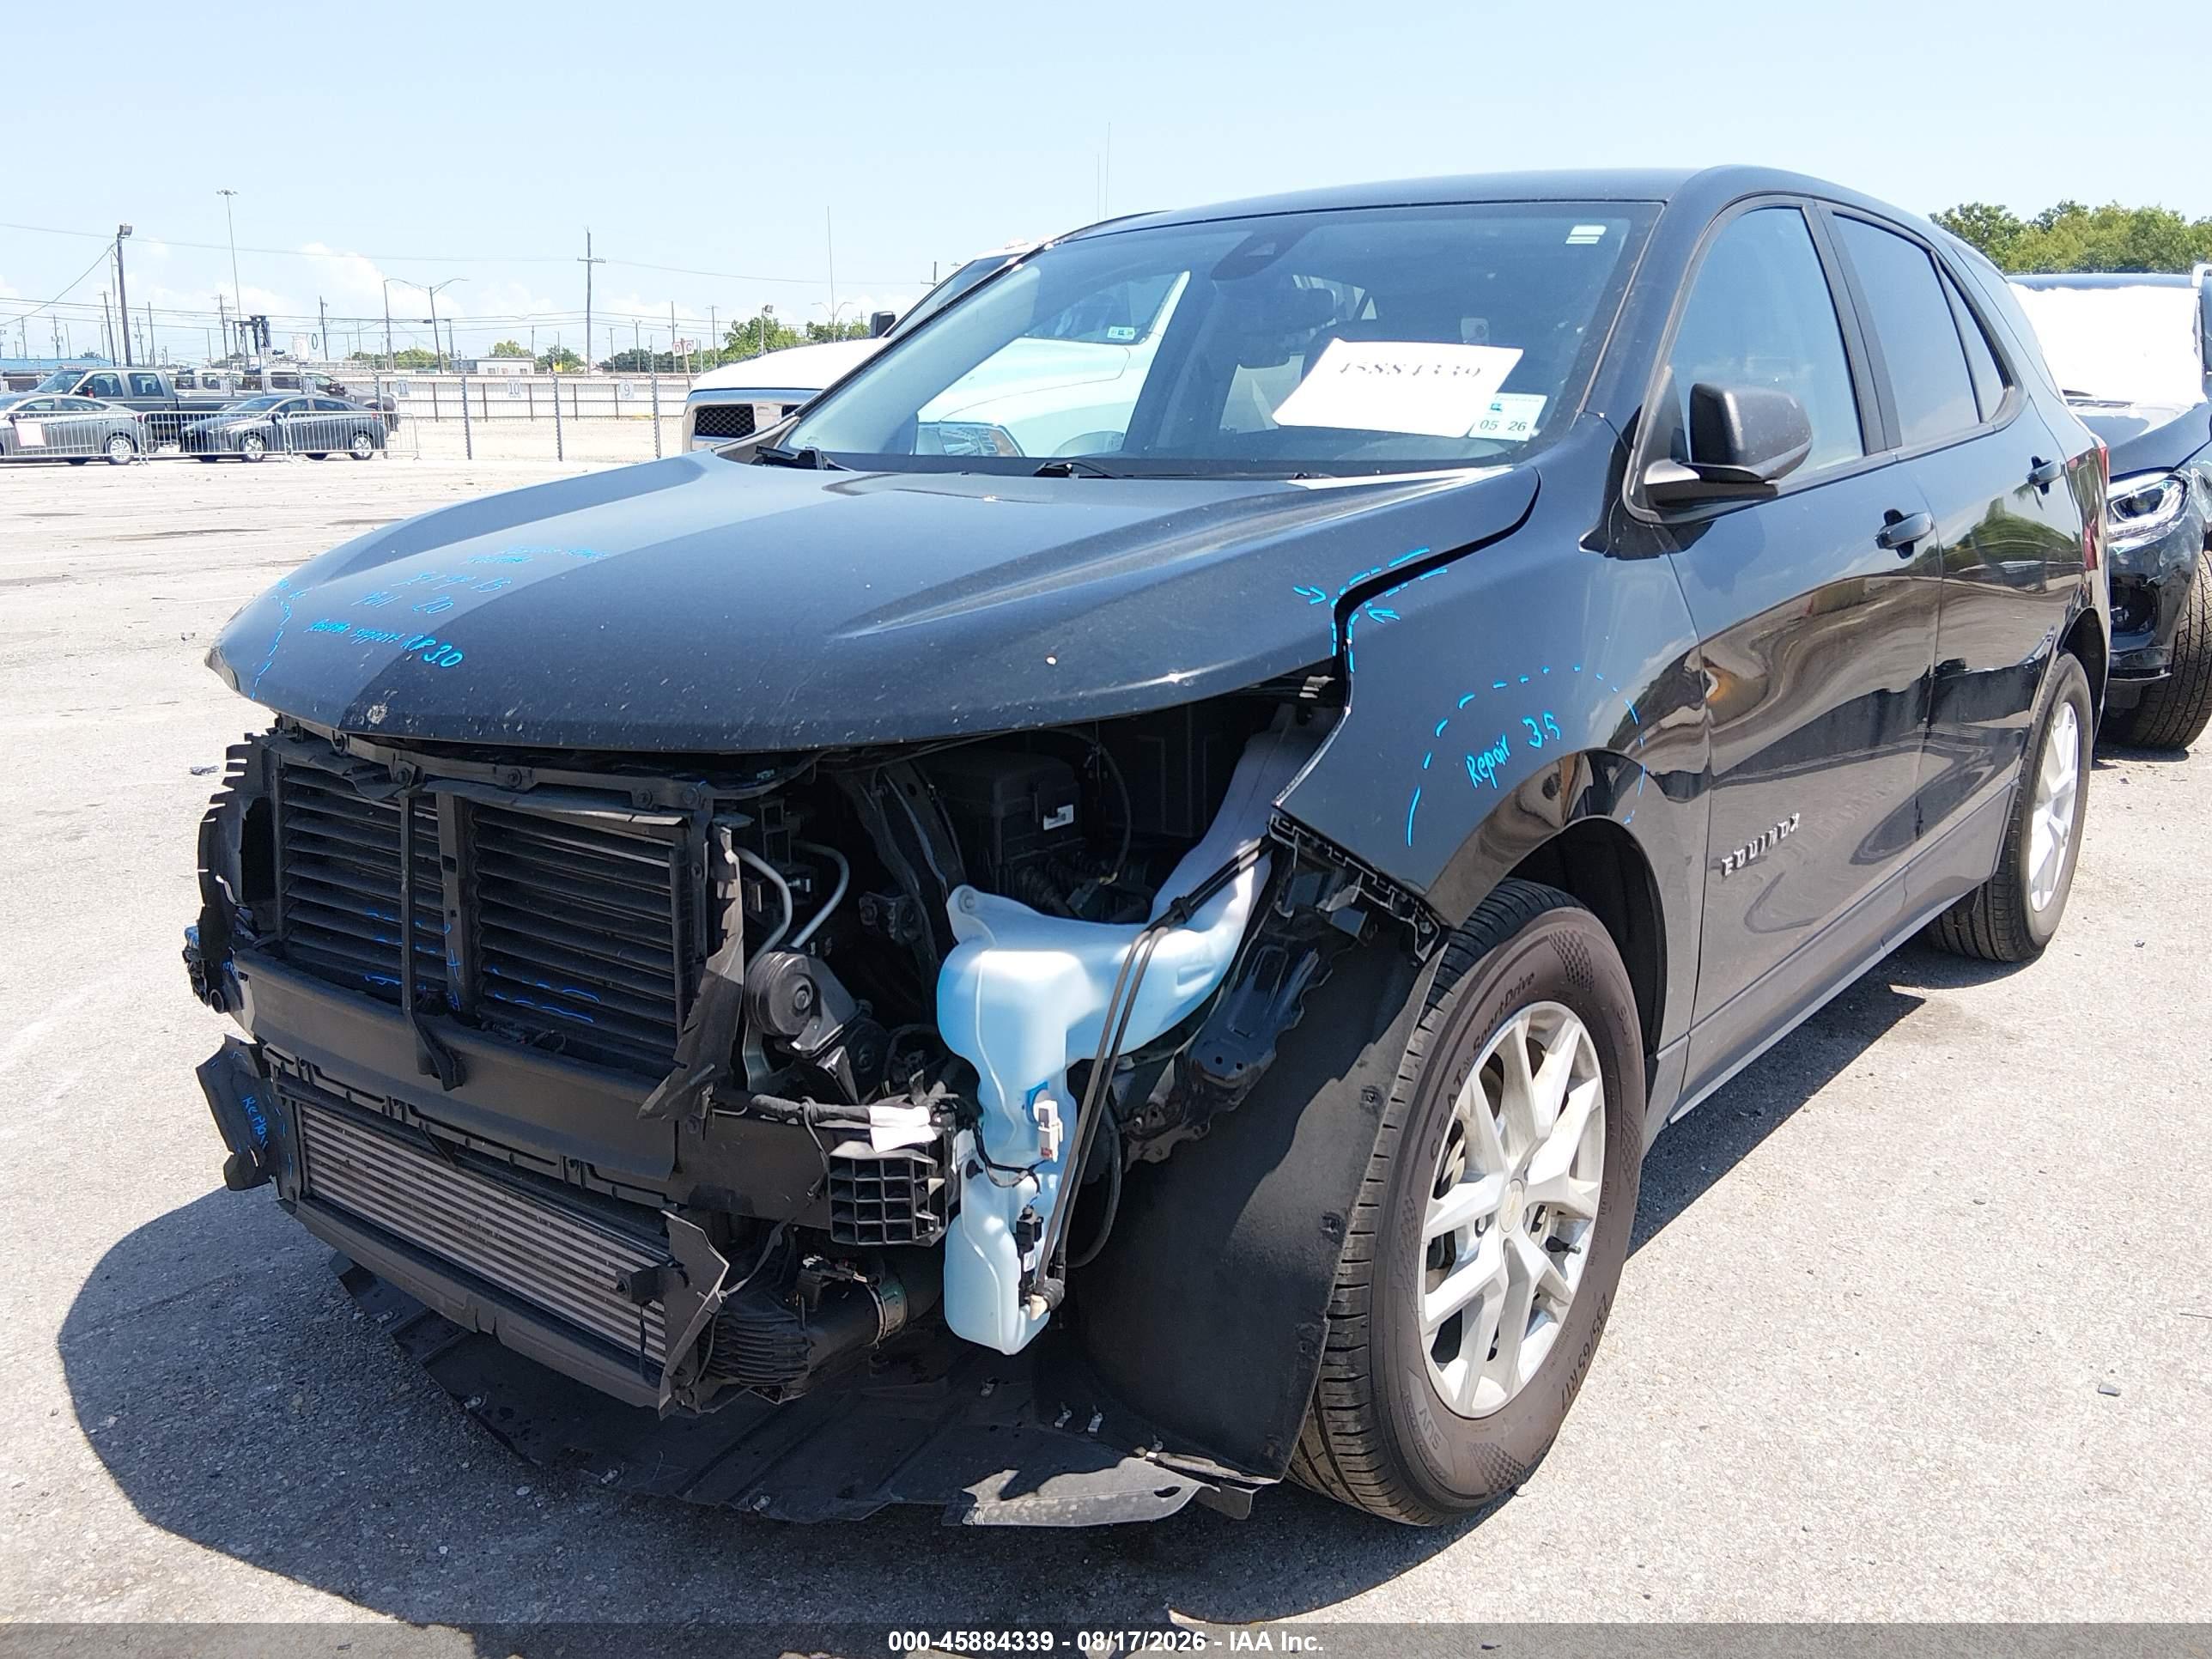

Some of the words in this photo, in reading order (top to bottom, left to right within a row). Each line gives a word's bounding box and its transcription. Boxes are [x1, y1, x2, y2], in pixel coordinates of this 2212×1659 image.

[509, 383, 520, 395] 10
[623, 384, 630, 397] 9
[1480, 419, 1499, 431] 05
[1507, 420, 1527, 432] 26
[421, 644, 465, 668] 3.0
[1466, 734, 1510, 789] Repair
[1522, 712, 1560, 749] 3.5
[1721, 811, 1800, 877] EQUINOX
